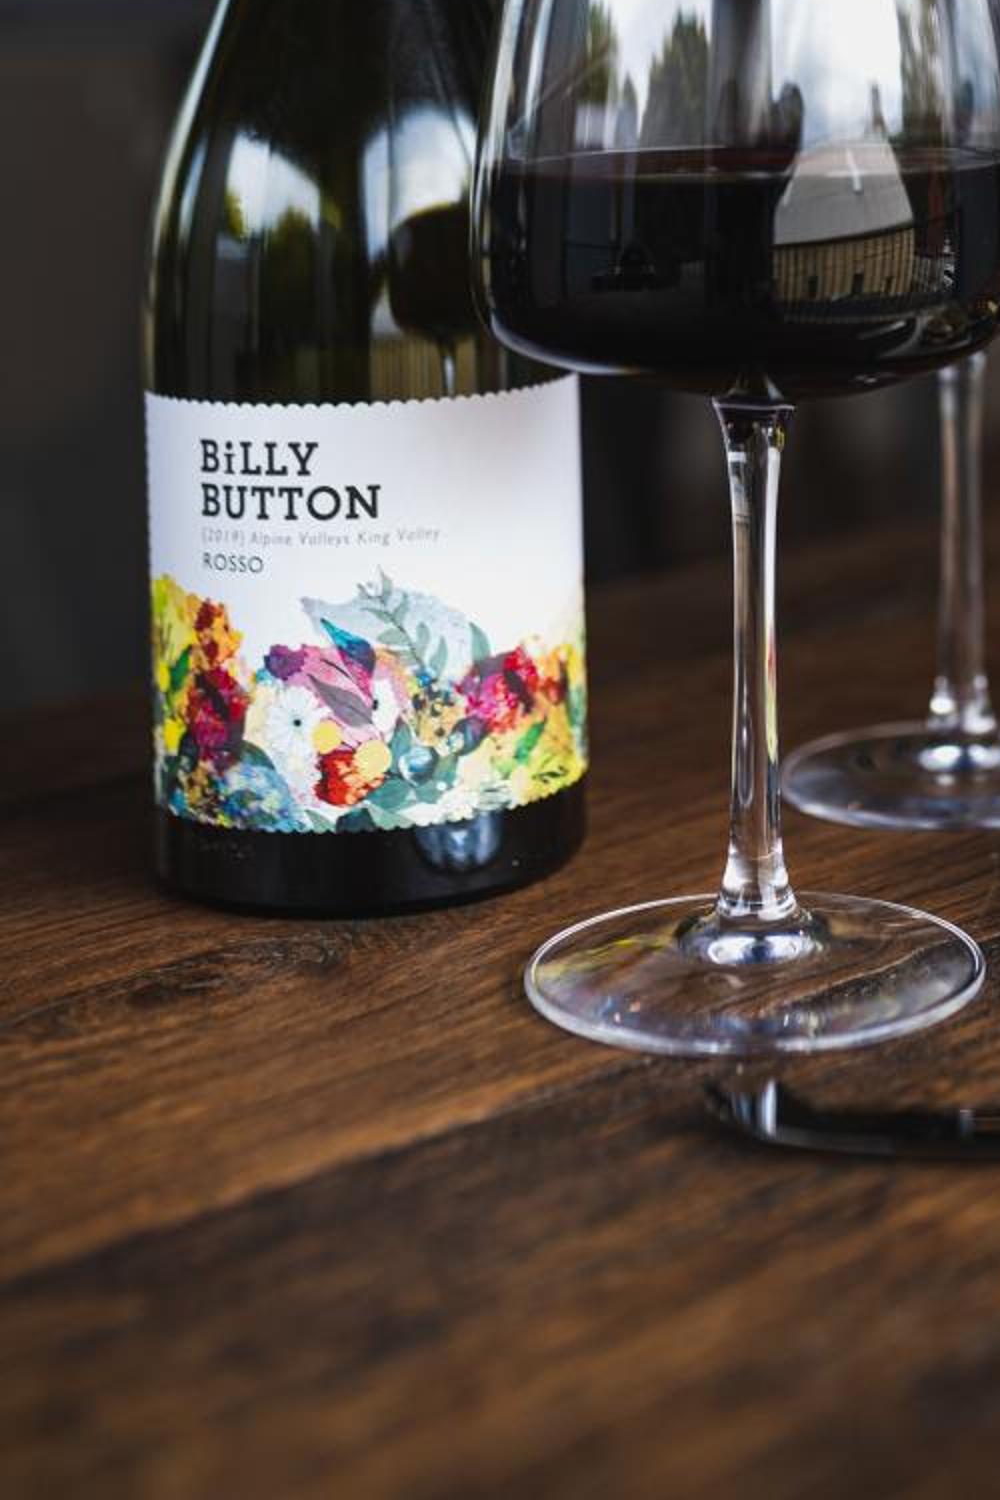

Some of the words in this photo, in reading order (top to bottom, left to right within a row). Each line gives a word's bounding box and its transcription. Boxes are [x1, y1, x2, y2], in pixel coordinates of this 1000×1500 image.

[200, 438, 318, 476] BiLLY
[201, 482, 381, 520] BUTTON
[251, 528, 292, 548] Alpine
[300, 529, 350, 548] Valleys
[357, 526, 390, 546] King
[397, 523, 440, 542] Valley
[203, 552, 264, 573] ROSSO
